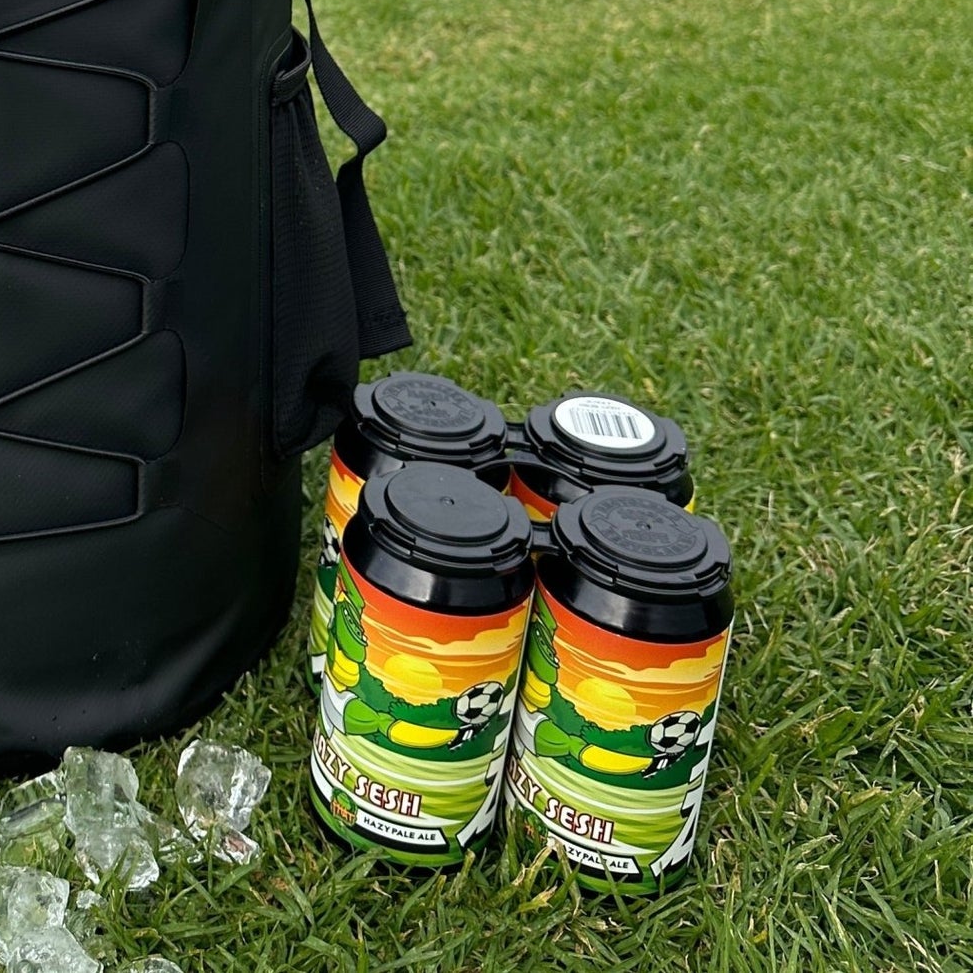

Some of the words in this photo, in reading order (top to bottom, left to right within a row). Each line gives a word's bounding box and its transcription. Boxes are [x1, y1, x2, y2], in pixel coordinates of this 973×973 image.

[354, 774, 422, 817] SESH
[507, 755, 541, 805] AZY
[544, 797, 615, 844] SESH
[363, 816, 391, 833] HAZY
[391, 828, 415, 840] PALE
[417, 832, 437, 841] ALE
[610, 860, 629, 870] ALE
